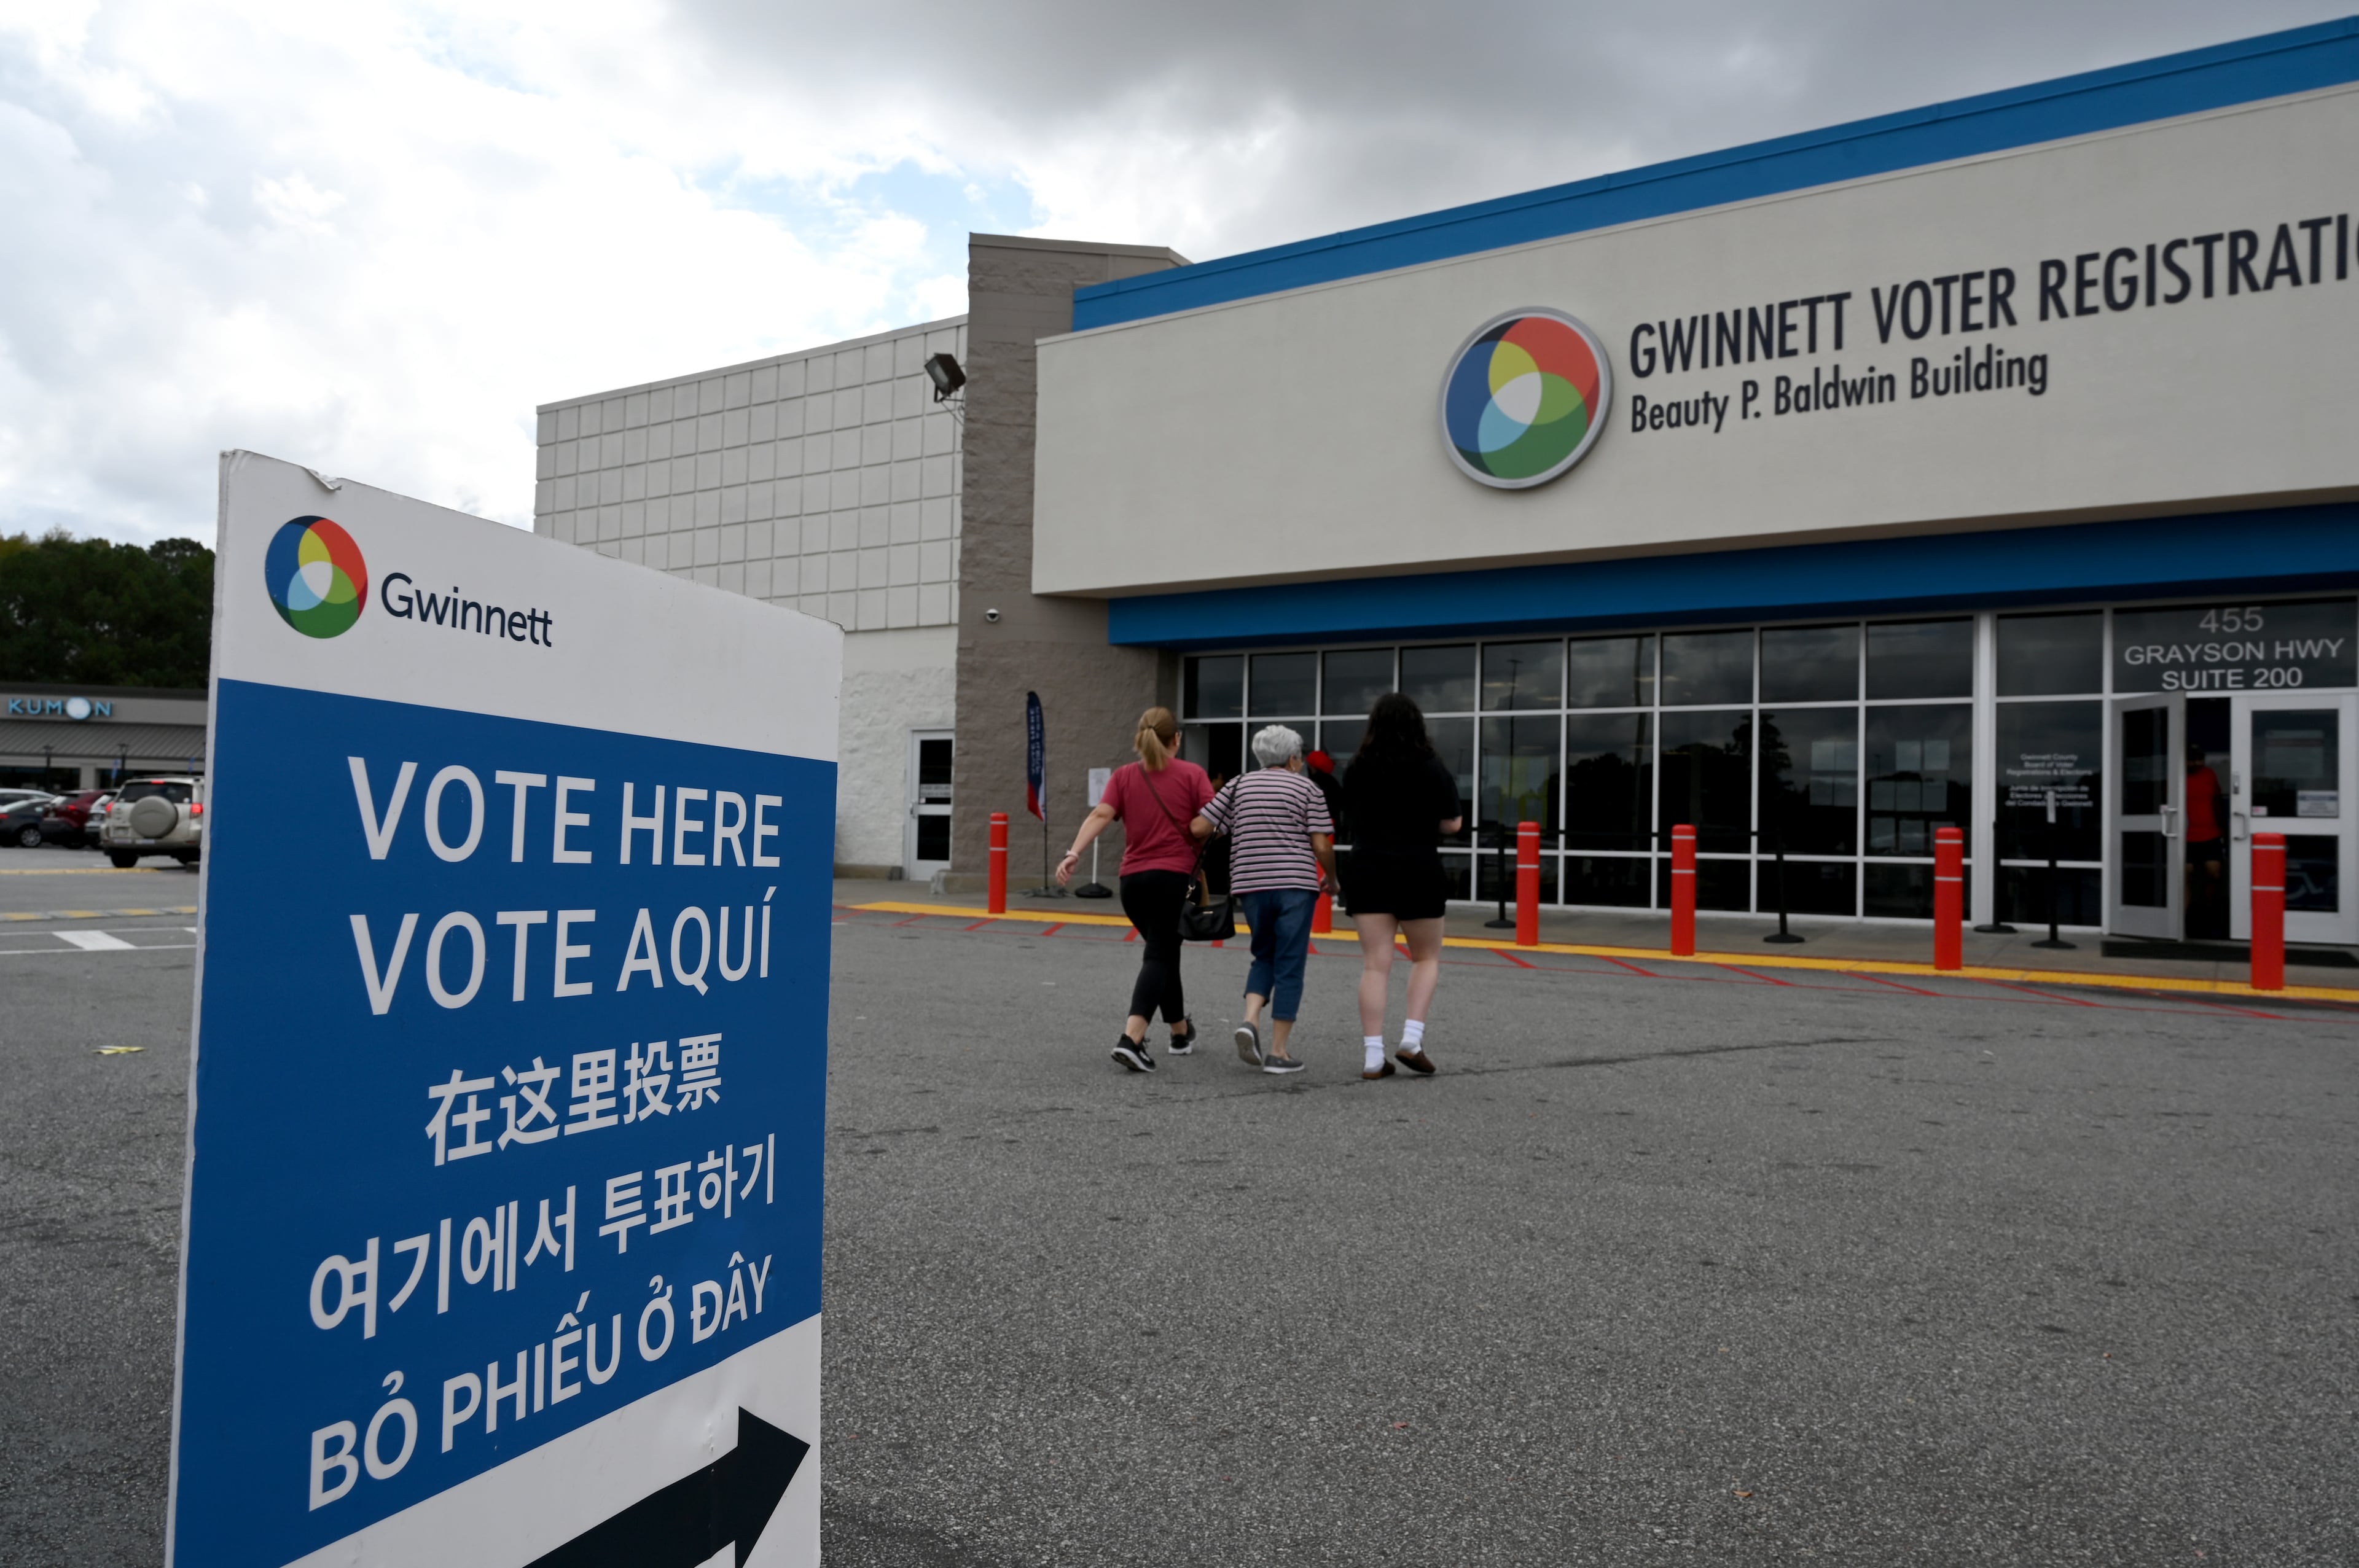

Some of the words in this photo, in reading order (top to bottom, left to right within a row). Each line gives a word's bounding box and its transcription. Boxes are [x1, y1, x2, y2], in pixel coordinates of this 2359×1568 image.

[1630, 291, 1852, 378] GWINNETT
[1871, 267, 2017, 344] VOTER
[2039, 213, 2359, 322] REGISTRATI
[1631, 391, 1729, 434] Beauty
[1742, 380, 1761, 420] P.
[1774, 364, 1896, 416] Baldwin
[1911, 343, 2048, 399] Building
[381, 572, 553, 647] Gwinnett
[2124, 641, 2265, 665] GRAYSON
[2274, 638, 2344, 660] HWY
[2199, 607, 2264, 634] 455
[9, 696, 112, 720] KUMON
[2161, 668, 2245, 690] SUITE
[2253, 667, 2303, 688] 200
[347, 756, 595, 864] VOTE
[620, 782, 783, 867] HERE
[350, 909, 596, 1015] VOTE
[616, 886, 777, 996] AQUÍ
[424, 1032, 723, 1167] 在这里投票
[310, 1185, 576, 1340] 여기에서
[598, 1133, 775, 1254] 투표하기
[309, 1370, 418, 1512] BỎ
[442, 1290, 622, 1454] PHIẾU
[638, 1274, 675, 1362] Ở
[690, 1251, 772, 1344] ĐÂY
